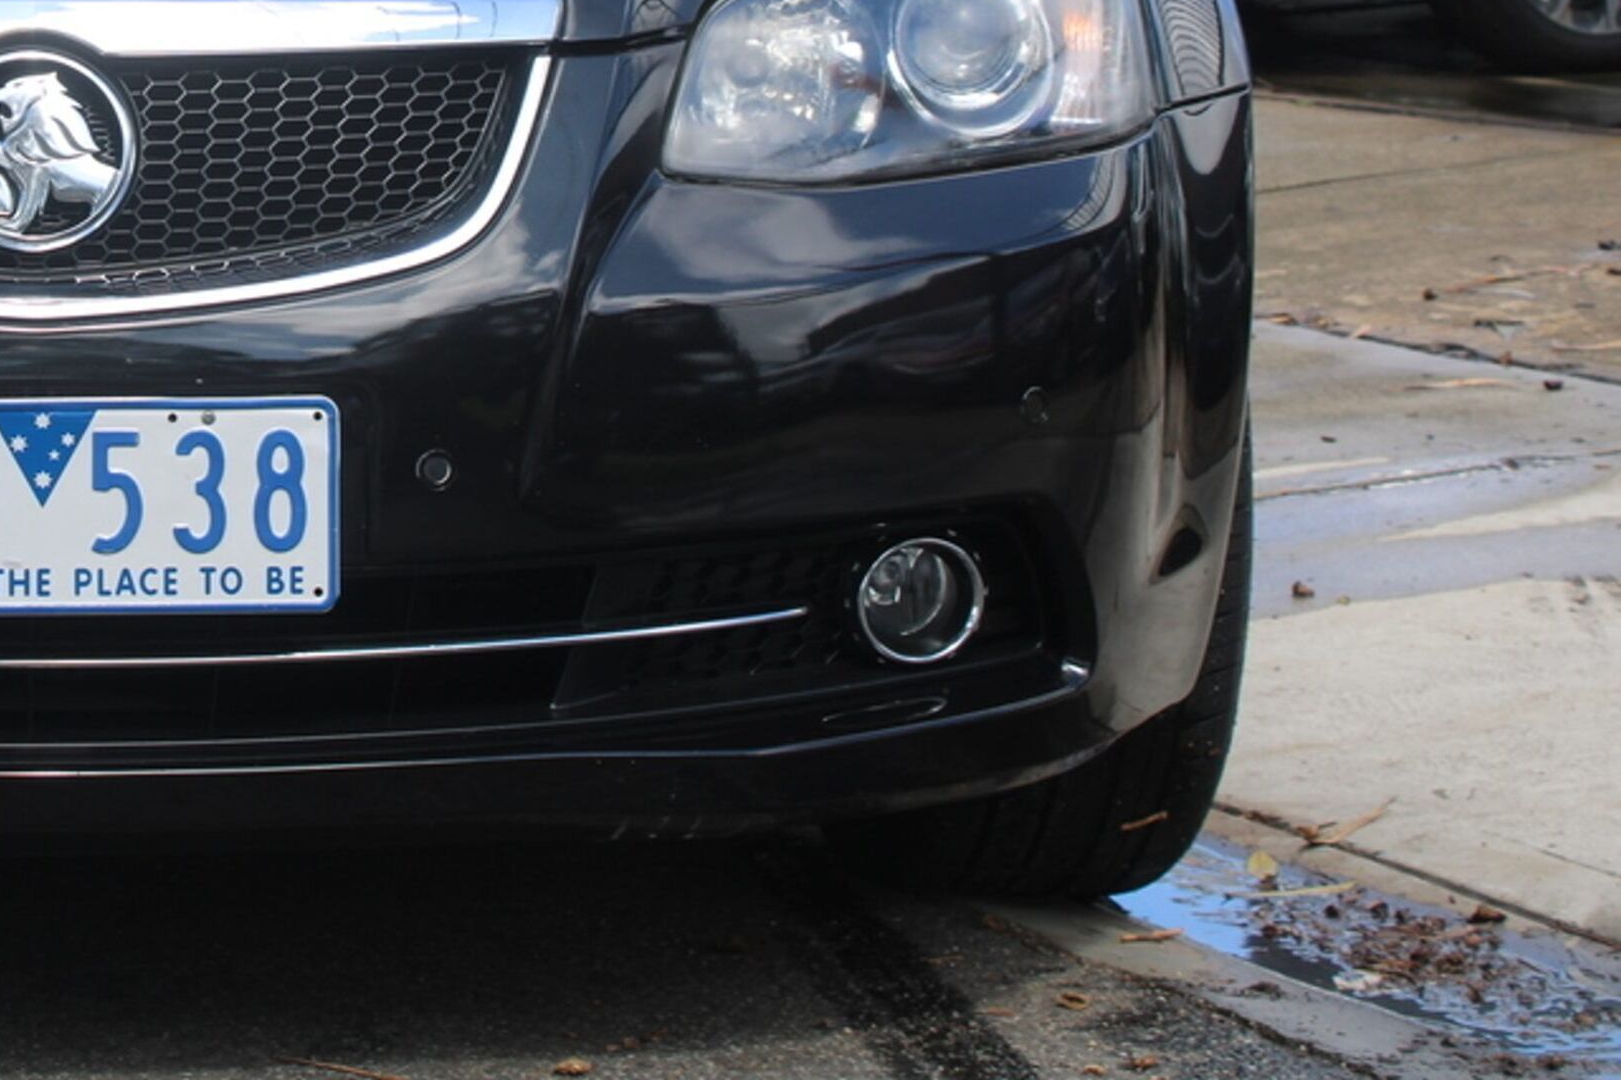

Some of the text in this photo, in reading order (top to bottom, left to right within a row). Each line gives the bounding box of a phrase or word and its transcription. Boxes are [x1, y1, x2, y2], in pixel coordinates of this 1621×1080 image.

[91, 428, 308, 555] 538
[74, 567, 179, 596] PLACE
[199, 567, 243, 595] TO
[266, 566, 304, 595] BE
